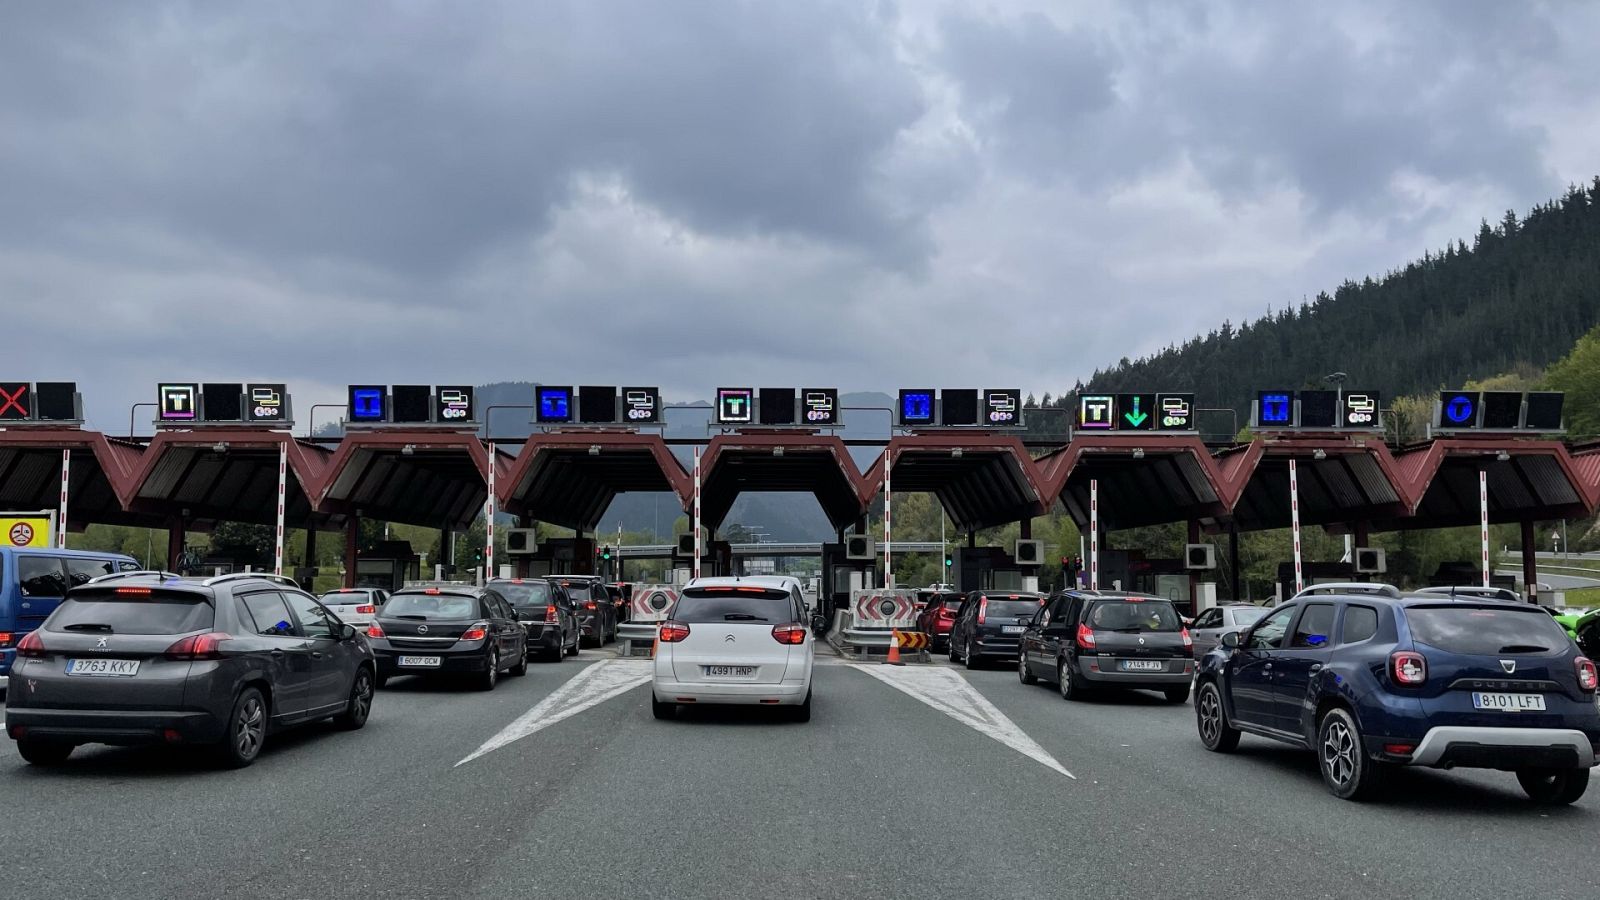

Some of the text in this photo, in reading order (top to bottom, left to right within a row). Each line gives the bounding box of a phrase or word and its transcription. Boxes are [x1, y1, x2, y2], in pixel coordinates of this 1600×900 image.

[168, 394, 187, 410] T
[358, 396, 377, 411] T
[544, 397, 565, 411] T
[726, 399, 744, 414] T
[1088, 405, 1106, 421] T
[1451, 402, 1467, 418] T
[75, 660, 136, 673] 3763 KKY
[711, 666, 752, 676] 4991 HNP
[1482, 694, 1541, 708] 8101 LFT
